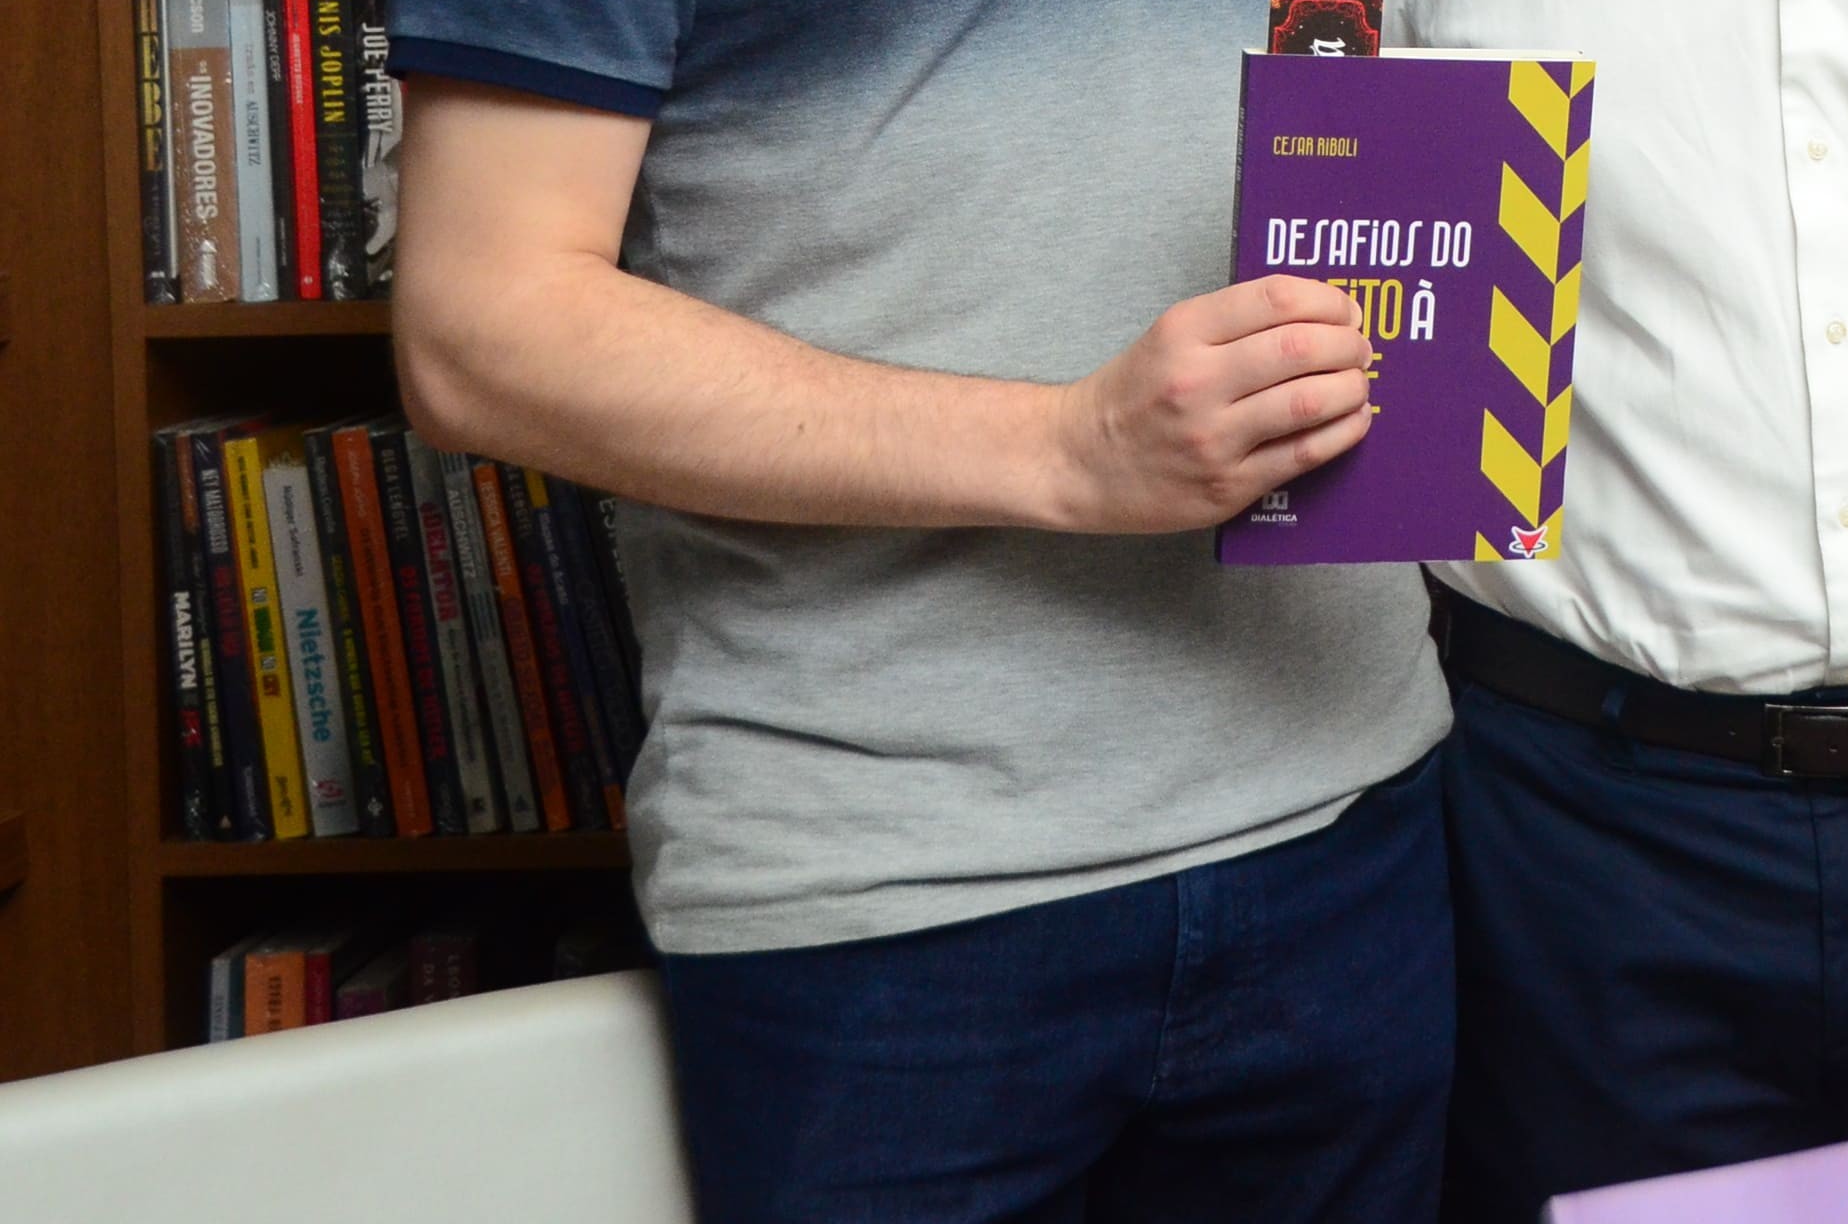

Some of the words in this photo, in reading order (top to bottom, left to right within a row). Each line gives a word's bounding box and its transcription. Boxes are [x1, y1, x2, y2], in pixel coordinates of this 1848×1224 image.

[321, 45, 345, 123] JOPLIN
[188, 76, 218, 218] INOVADORES
[1274, 136, 1314, 157] CESAR
[1266, 218, 1422, 267] DESAFIOS
[1431, 222, 1472, 268] DO
[1410, 280, 1436, 341] À
[172, 591, 198, 690] MARILYN
[295, 608, 334, 743] Nietzsche
